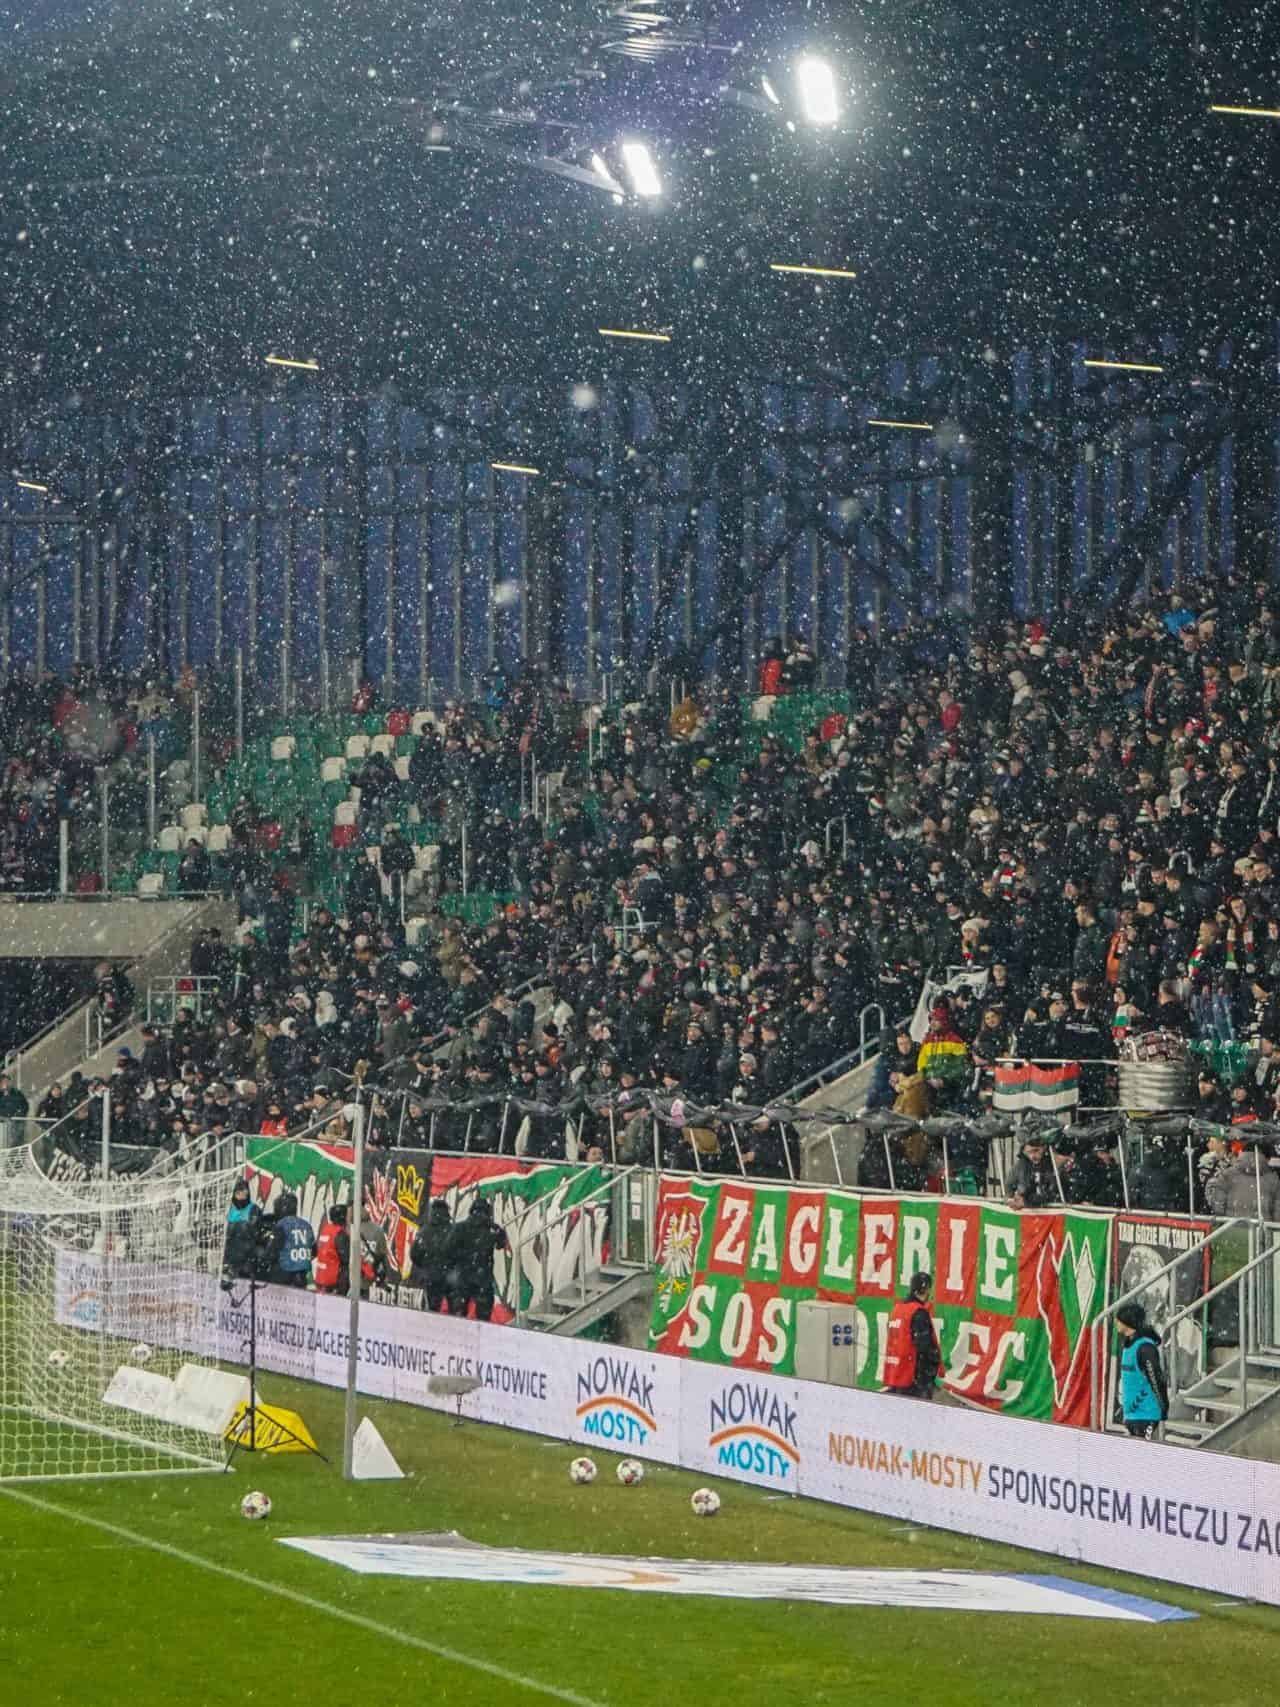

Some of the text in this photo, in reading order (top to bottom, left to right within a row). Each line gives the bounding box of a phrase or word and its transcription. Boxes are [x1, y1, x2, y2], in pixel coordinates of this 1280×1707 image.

[291, 1229, 307, 1246] TV
[365, 1339, 436, 1376] SOSNOWIEC
[476, 1361, 547, 1400] KATOWICE
[577, 1357, 655, 1416] NOWAK
[584, 1410, 647, 1446] MOSTY
[711, 1382, 798, 1447] NOWAK
[718, 1440, 790, 1478] MOSTY
[828, 1432, 983, 1493] NOWAK-MOSTY
[989, 1464, 1133, 1526] SPONSOREM
[1140, 1494, 1229, 1546] MECZU
